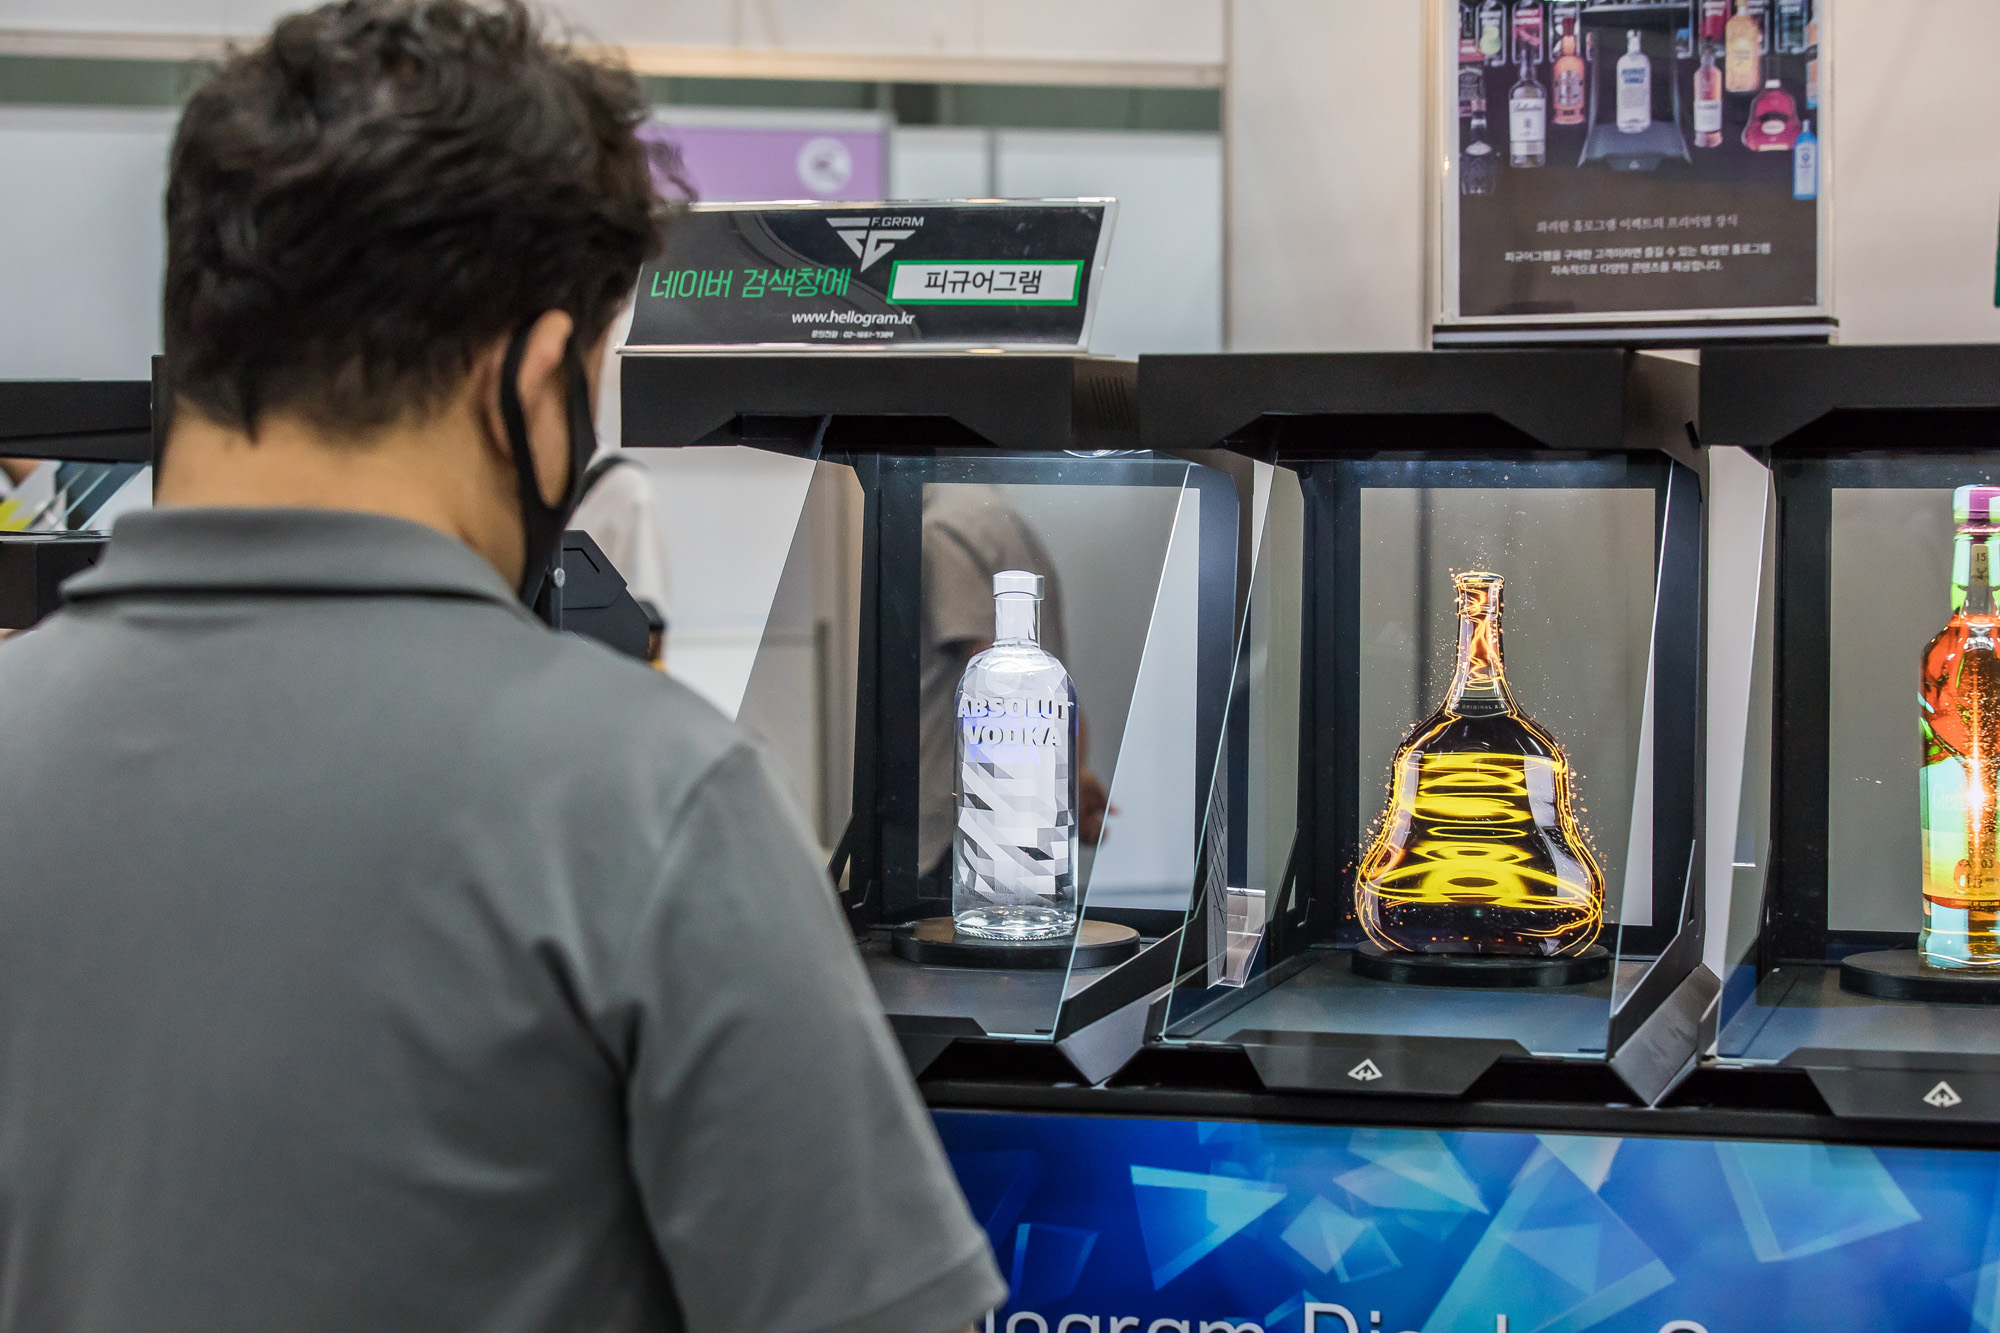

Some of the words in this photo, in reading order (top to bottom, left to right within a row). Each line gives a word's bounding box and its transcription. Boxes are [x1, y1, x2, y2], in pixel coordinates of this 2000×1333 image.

[871, 216, 925, 228] F.GRAM
[650, 269, 734, 299] 네이버
[741, 267, 852, 298] 검색창에
[924, 269, 1043, 295] 피규어그램
[791, 309, 916, 328] www.hellogram.kr
[1976, 552, 1987, 562] 15
[957, 697, 1074, 720] ABSOLUT
[964, 725, 1063, 747] VODKA
